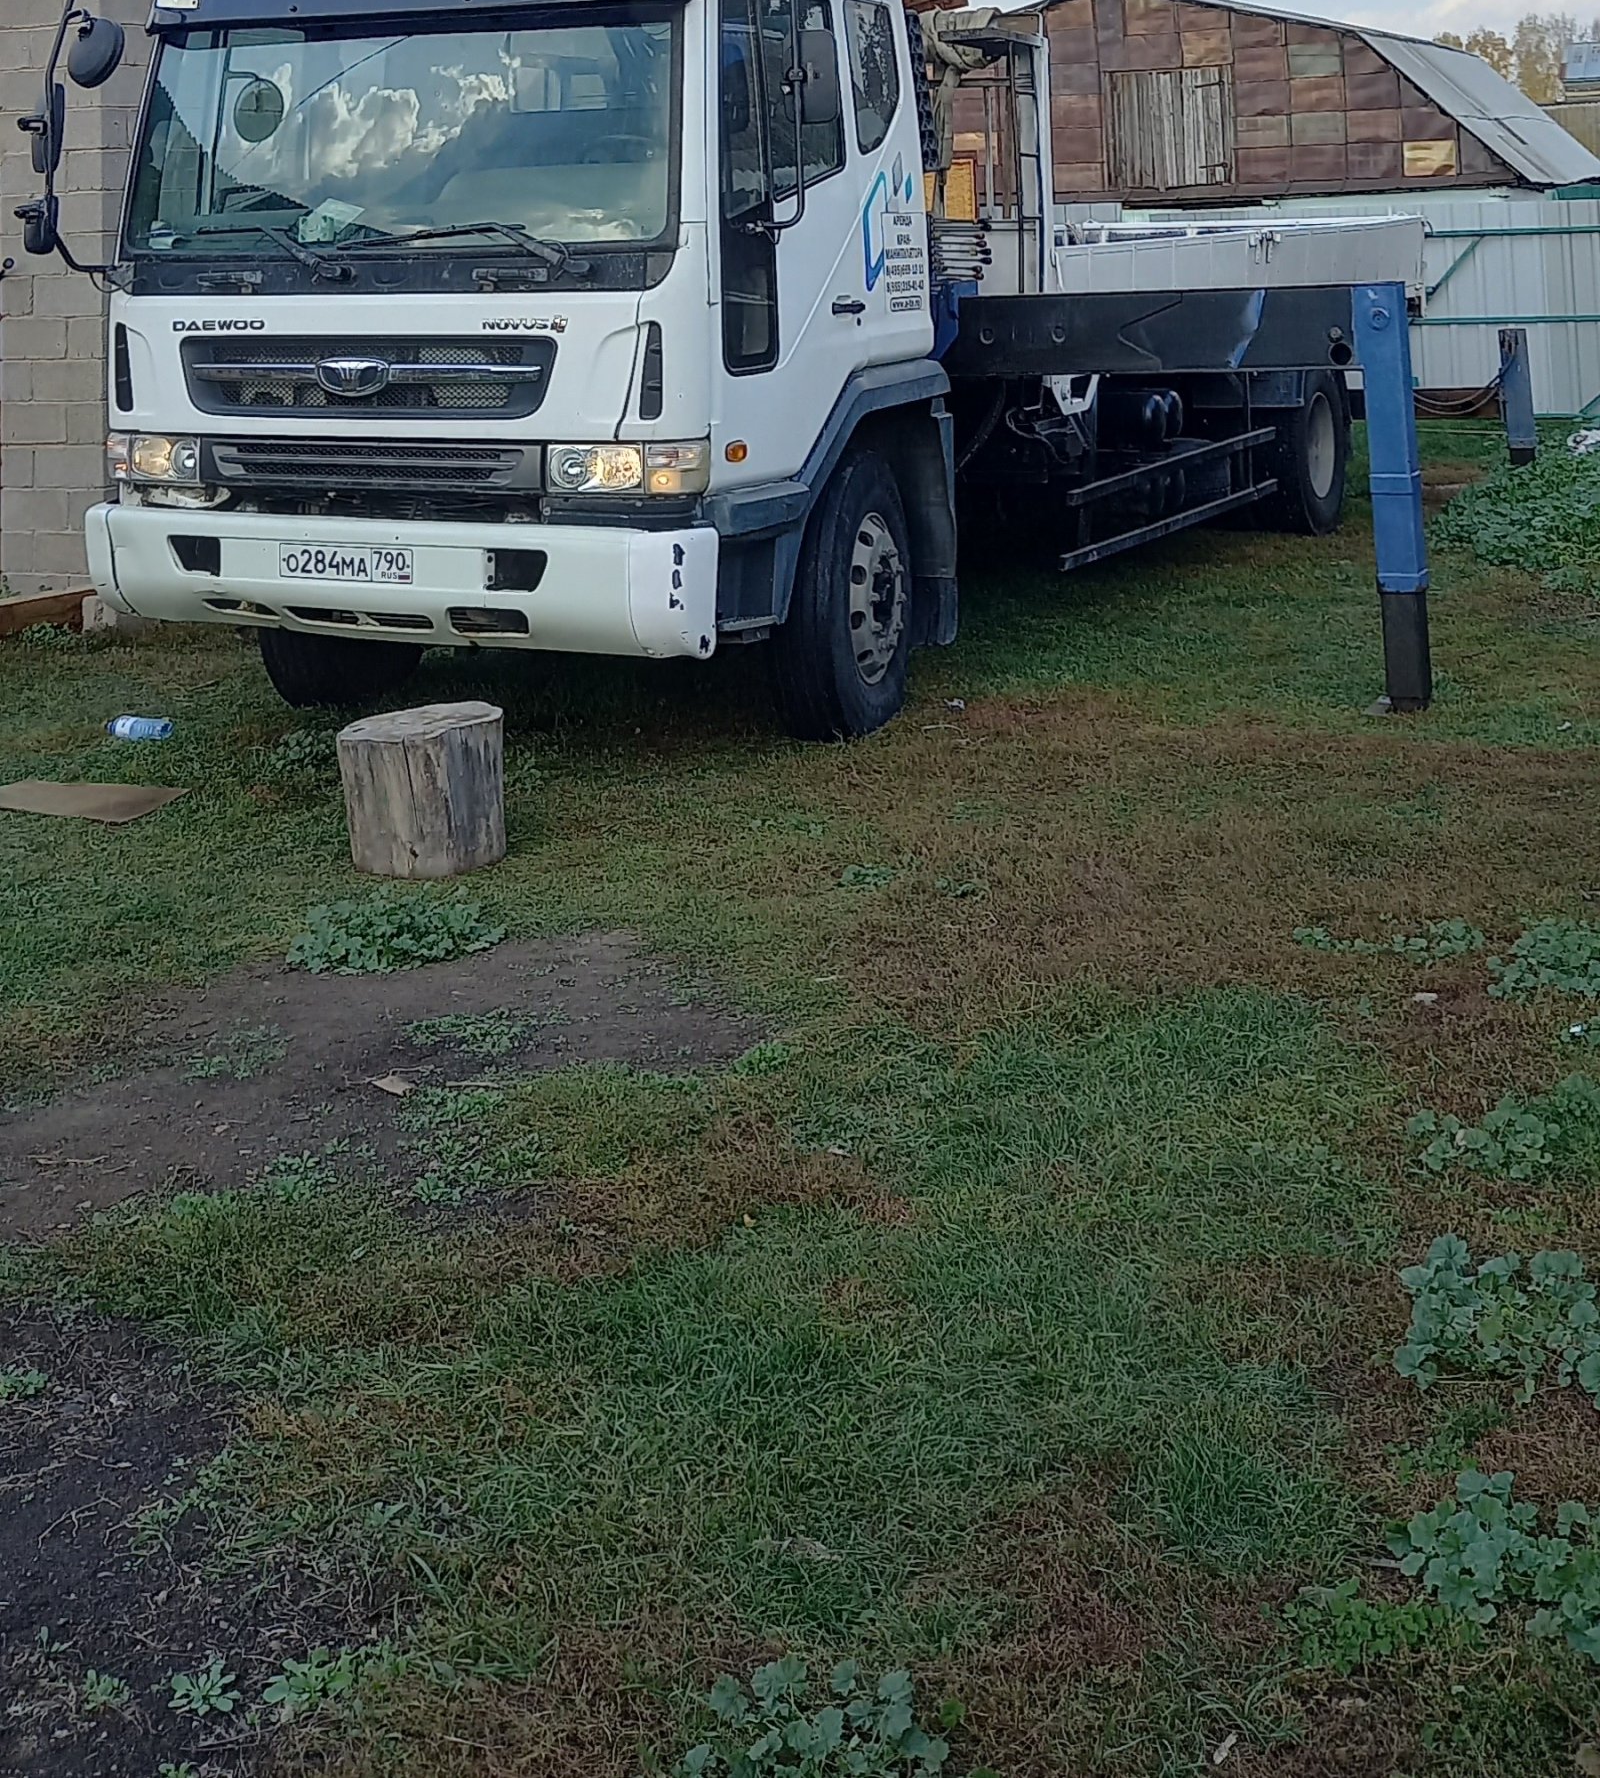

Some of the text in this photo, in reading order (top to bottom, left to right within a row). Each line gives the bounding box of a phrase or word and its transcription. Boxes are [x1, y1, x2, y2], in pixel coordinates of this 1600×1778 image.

[893, 215, 912, 226] АРЕНДА
[172, 319, 265, 332] DAEWOO
[481, 318, 550, 331] NOVUS
[372, 550, 407, 572] 790
[381, 570, 398, 580] RUS
